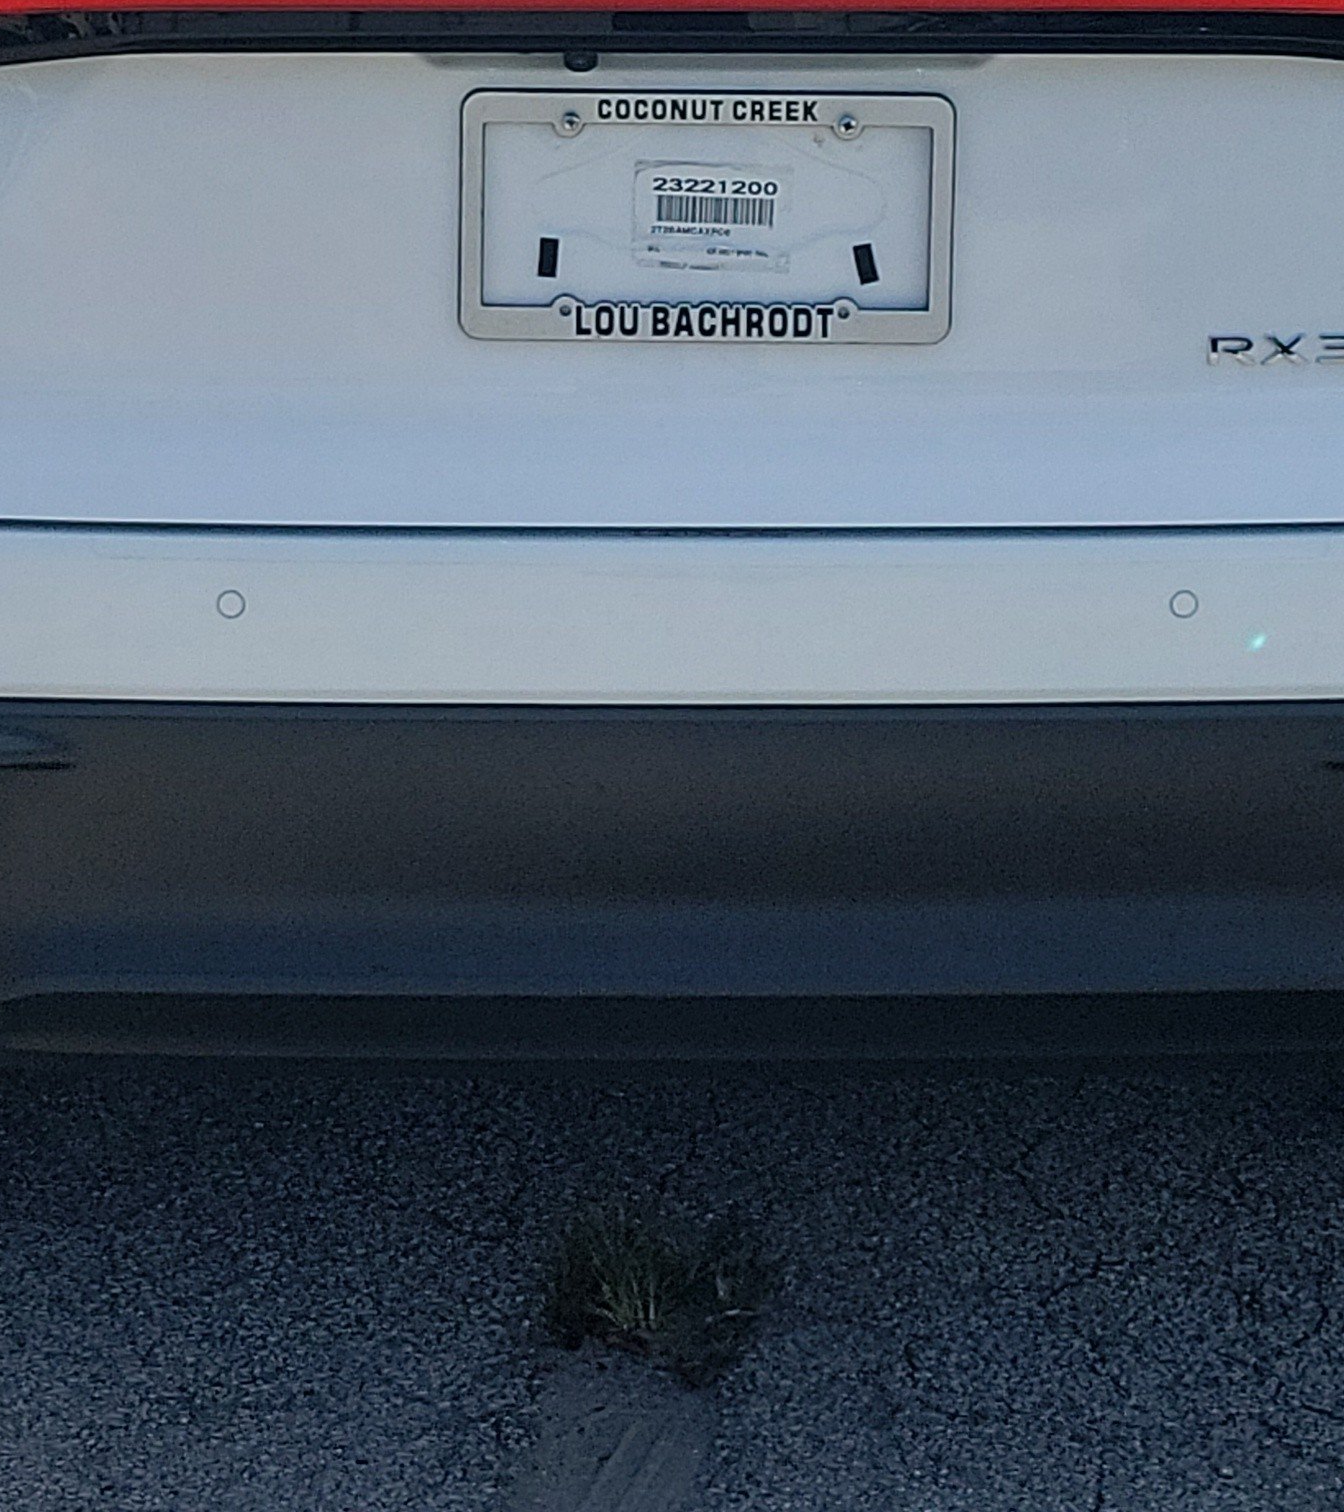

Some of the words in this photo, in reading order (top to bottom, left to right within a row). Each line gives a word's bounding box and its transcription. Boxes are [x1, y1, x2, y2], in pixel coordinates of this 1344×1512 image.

[597, 99, 722, 122] COCONUT
[732, 100, 819, 123] CREEK
[652, 177, 779, 196] 23221200
[574, 304, 640, 337] LOU
[652, 305, 835, 338] BACHRODT
